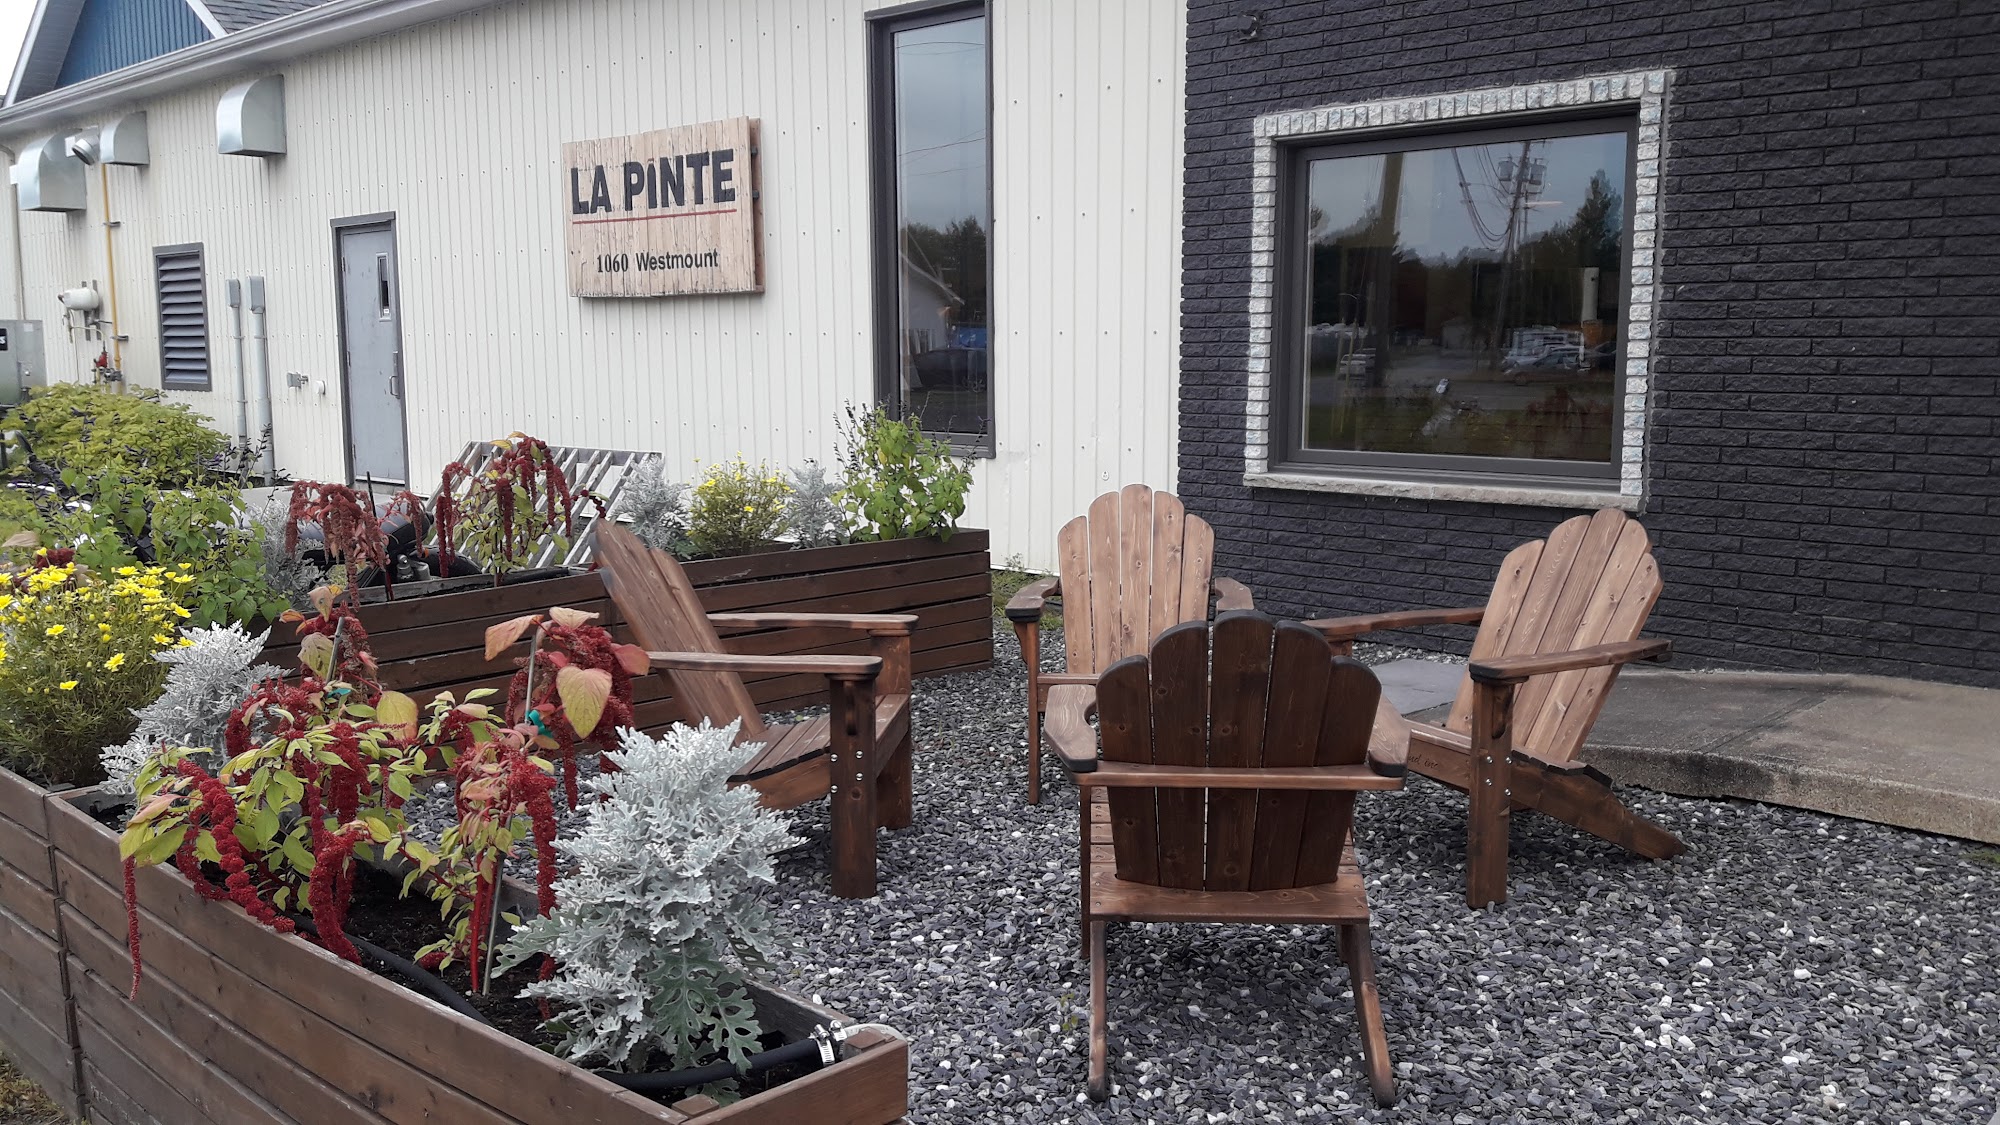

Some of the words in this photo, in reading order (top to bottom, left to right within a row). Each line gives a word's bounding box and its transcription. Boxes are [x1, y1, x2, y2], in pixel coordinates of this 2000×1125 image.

[571, 165, 612, 215] LA
[597, 253, 629, 273] 1060
[636, 248, 718, 272] Westmount
